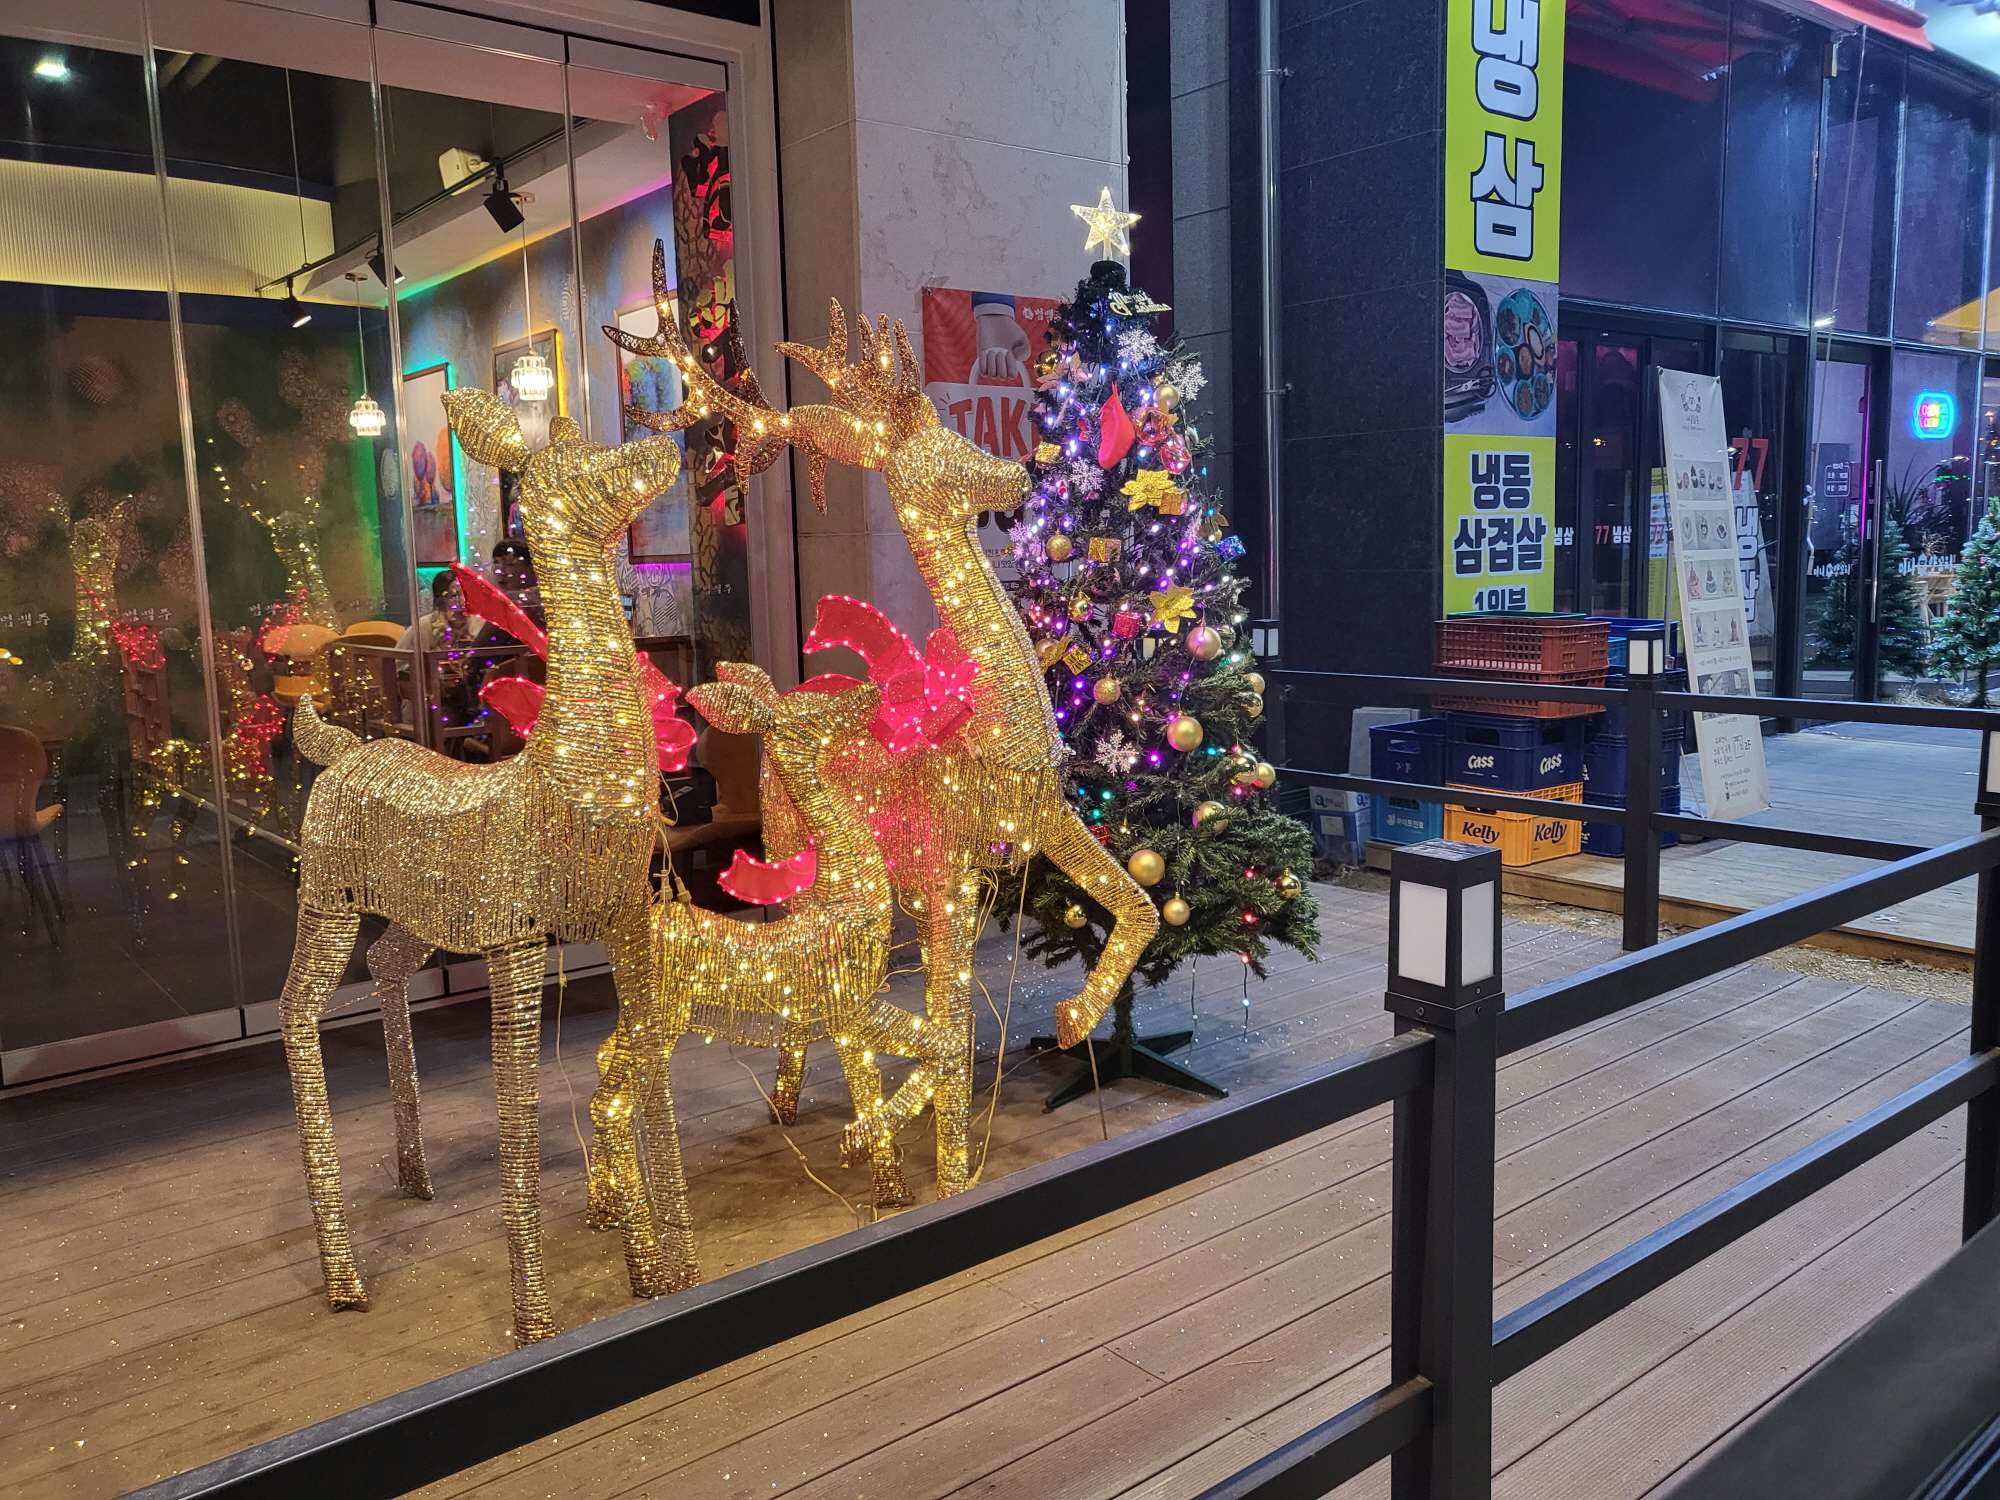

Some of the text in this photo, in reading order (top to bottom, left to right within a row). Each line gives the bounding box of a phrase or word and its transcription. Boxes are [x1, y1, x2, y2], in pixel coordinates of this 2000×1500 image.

[1470, 0, 1544, 262] 냉삼
[1732, 437, 1769, 490] 77
[1471, 453, 1532, 510] 냉동
[1454, 517, 1547, 575] 삼겹살
[1596, 526, 1632, 544] 77 냉삼
[1467, 755, 1495, 770] Cass
[1540, 753, 1562, 775] Cass
[1462, 822, 1500, 844] Kelly
[1534, 821, 1567, 844] Kelly
